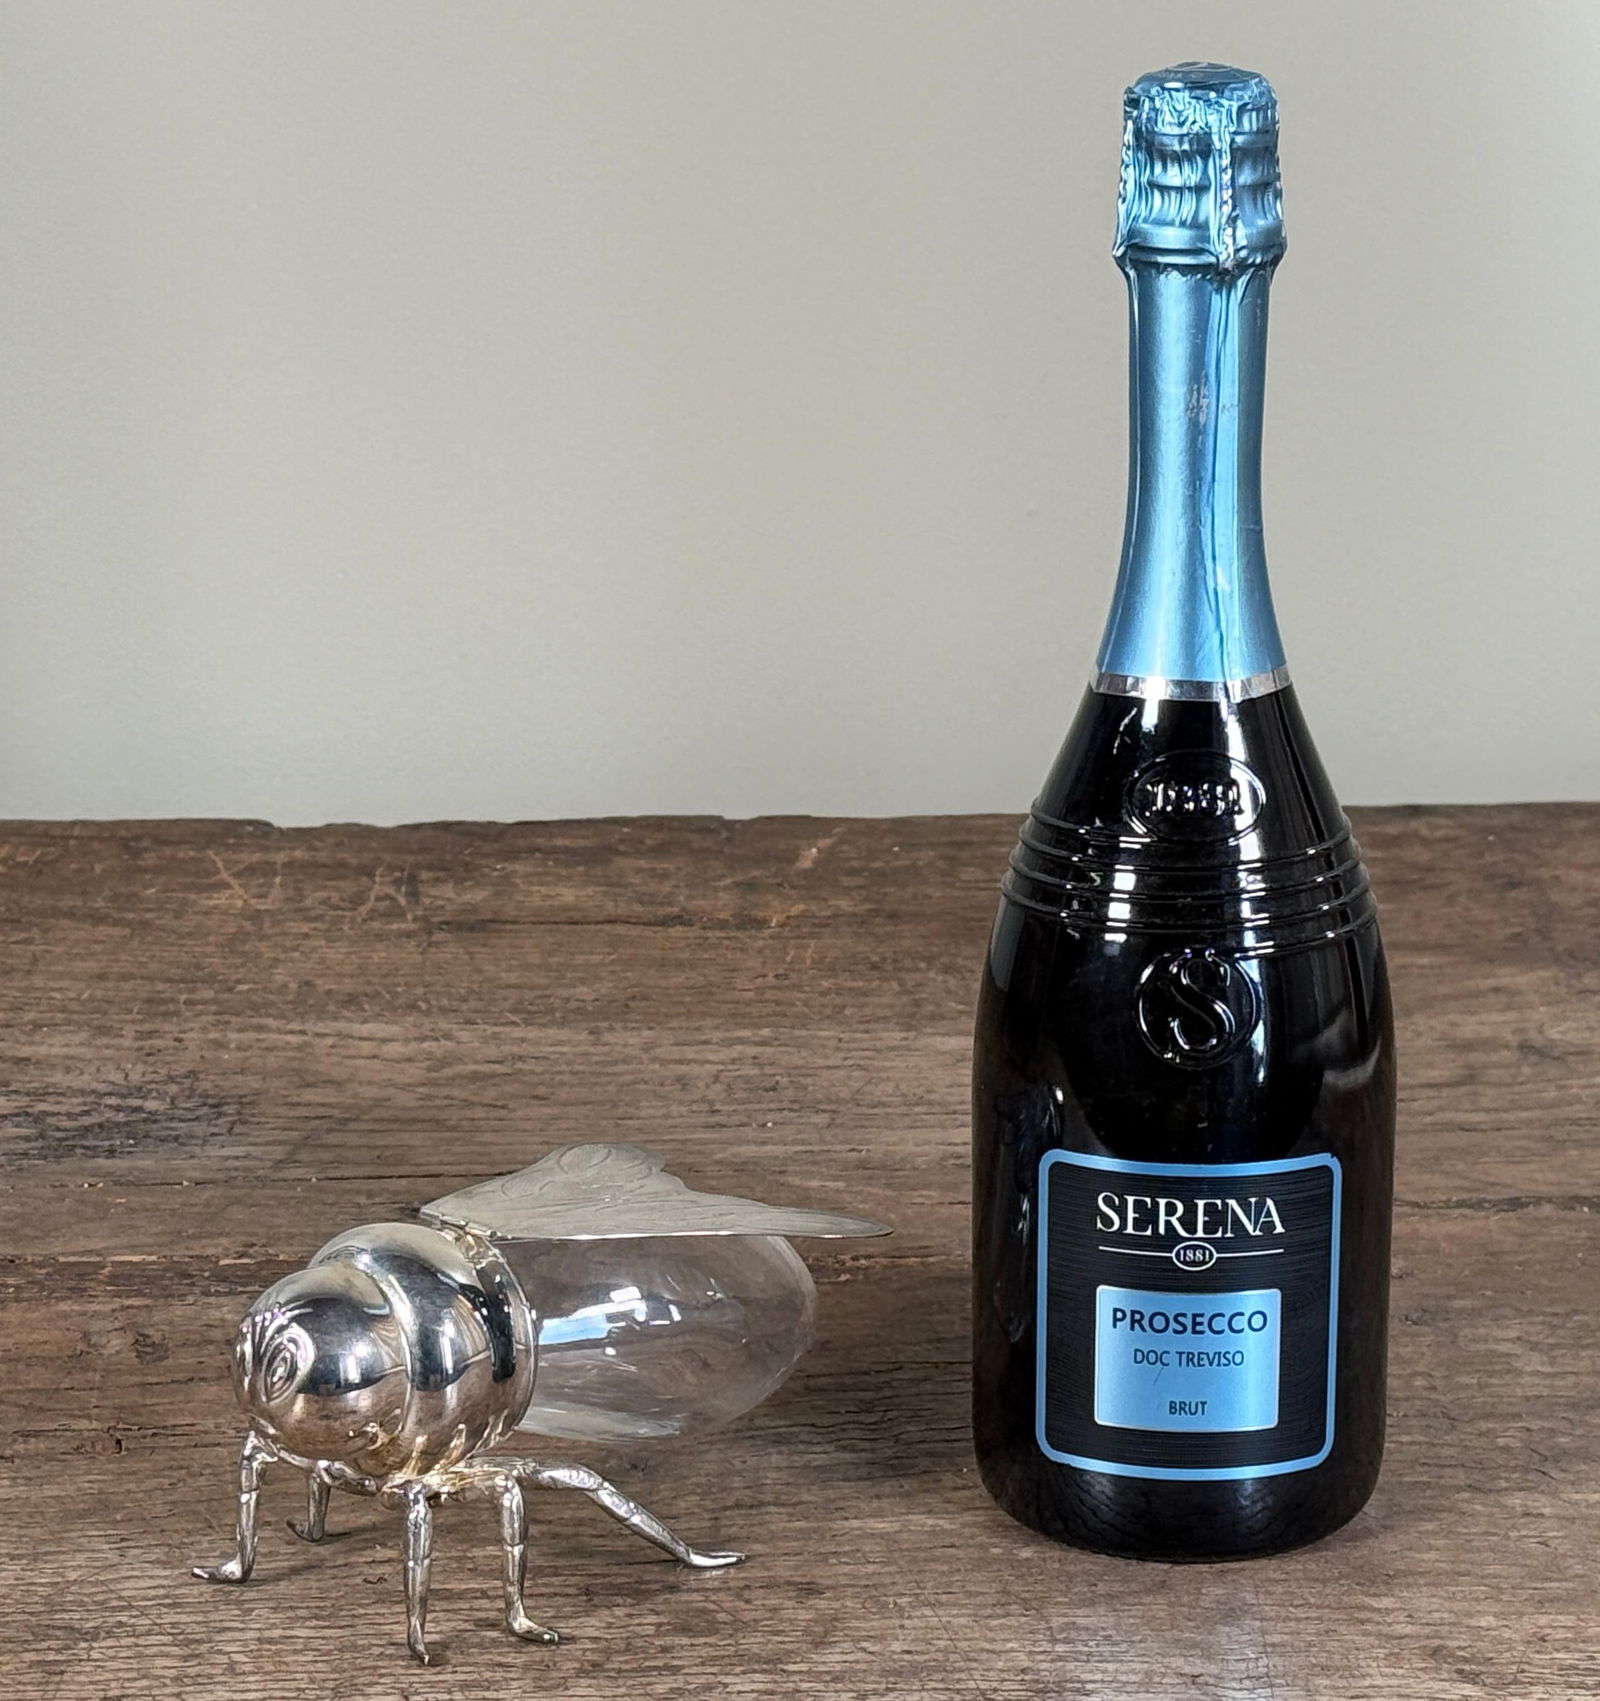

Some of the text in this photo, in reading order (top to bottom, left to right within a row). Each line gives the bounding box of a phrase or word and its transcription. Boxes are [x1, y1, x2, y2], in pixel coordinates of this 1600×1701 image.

[1168, 950, 1236, 1053] S
[1096, 1192, 1285, 1238] SERENA
[1178, 1249, 1211, 1264] 1881
[1112, 1307, 1268, 1335] PROSECCO
[1133, 1348, 1245, 1368] DOC TREVISO
[1168, 1400, 1207, 1416] BRUT
